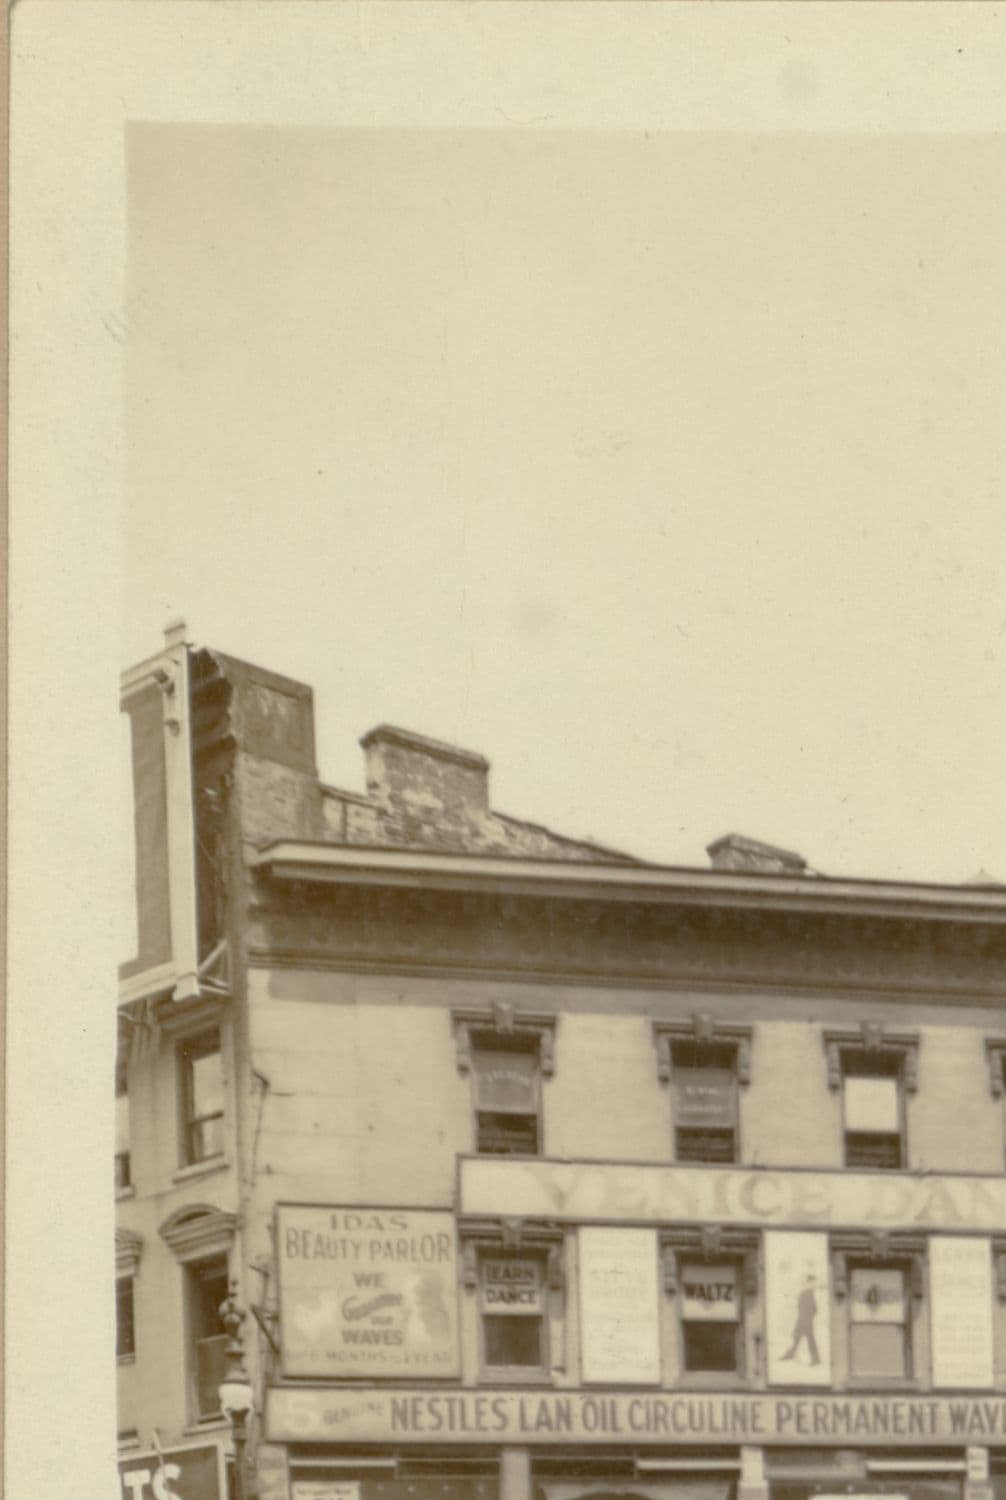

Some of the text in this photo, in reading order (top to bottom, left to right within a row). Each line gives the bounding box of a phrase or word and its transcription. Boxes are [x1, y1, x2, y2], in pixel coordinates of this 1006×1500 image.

[286, 1226, 450, 1263] BEAUTY PARLOR
[353, 1271, 385, 1289] WE
[683, 1283, 735, 1301] WALTZ
[341, 1328, 404, 1347] WAVES
[390, 1396, 508, 1432] NESTLES
[519, 1398, 573, 1432] LAN
[581, 1398, 624, 1433] OIL
[627, 1399, 766, 1433] CIRCULINE
[775, 1401, 940, 1435] PERMANENT
